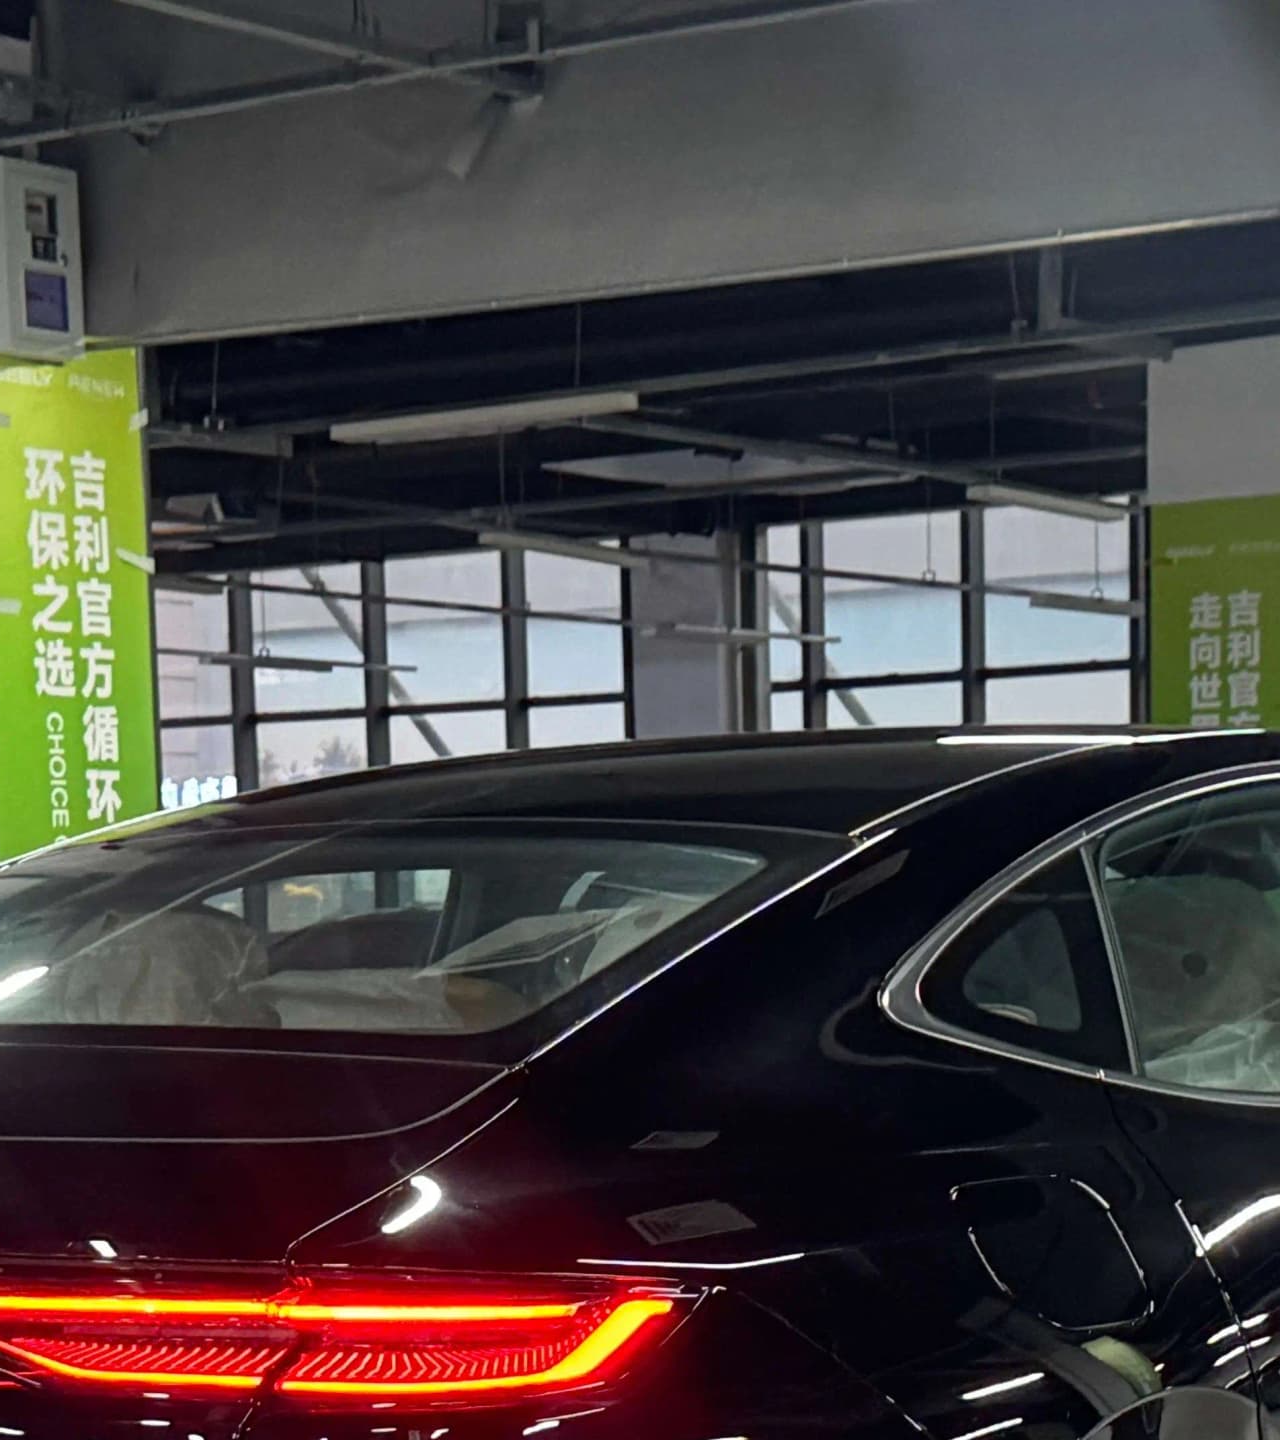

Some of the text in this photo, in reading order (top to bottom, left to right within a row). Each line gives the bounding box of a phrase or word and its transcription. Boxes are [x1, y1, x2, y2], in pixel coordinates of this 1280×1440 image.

[24, 448, 76, 698] 环保之选
[69, 450, 122, 824] 吉利官方循环
[46, 711, 70, 828] CHOICE
